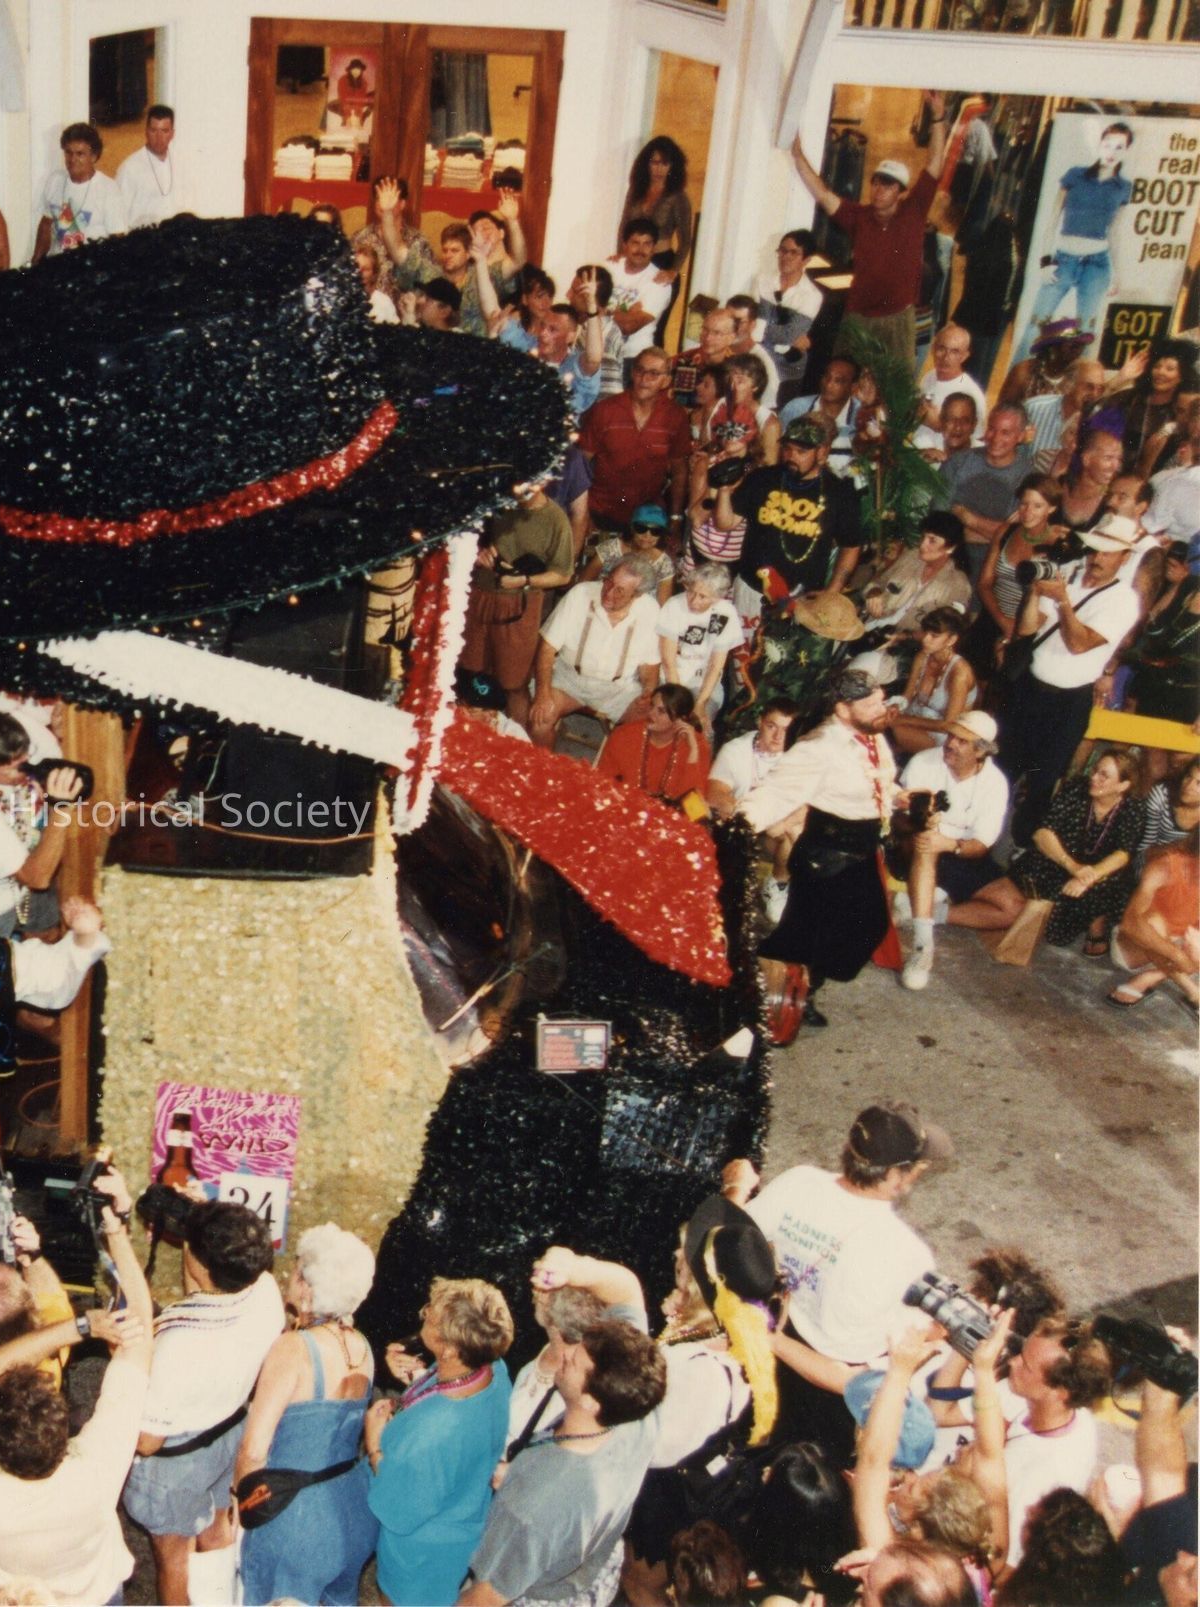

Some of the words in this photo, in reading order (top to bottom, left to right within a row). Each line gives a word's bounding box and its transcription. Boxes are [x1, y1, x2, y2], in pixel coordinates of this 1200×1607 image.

[1169, 132, 1198, 152] the
[1158, 154, 1200, 176] real
[1130, 178, 1200, 206] BOOT
[1134, 209, 1185, 237] CUT
[1138, 237, 1187, 263] jean
[1112, 309, 1164, 337] GOT
[782, 1212, 843, 1252] MADNESS
